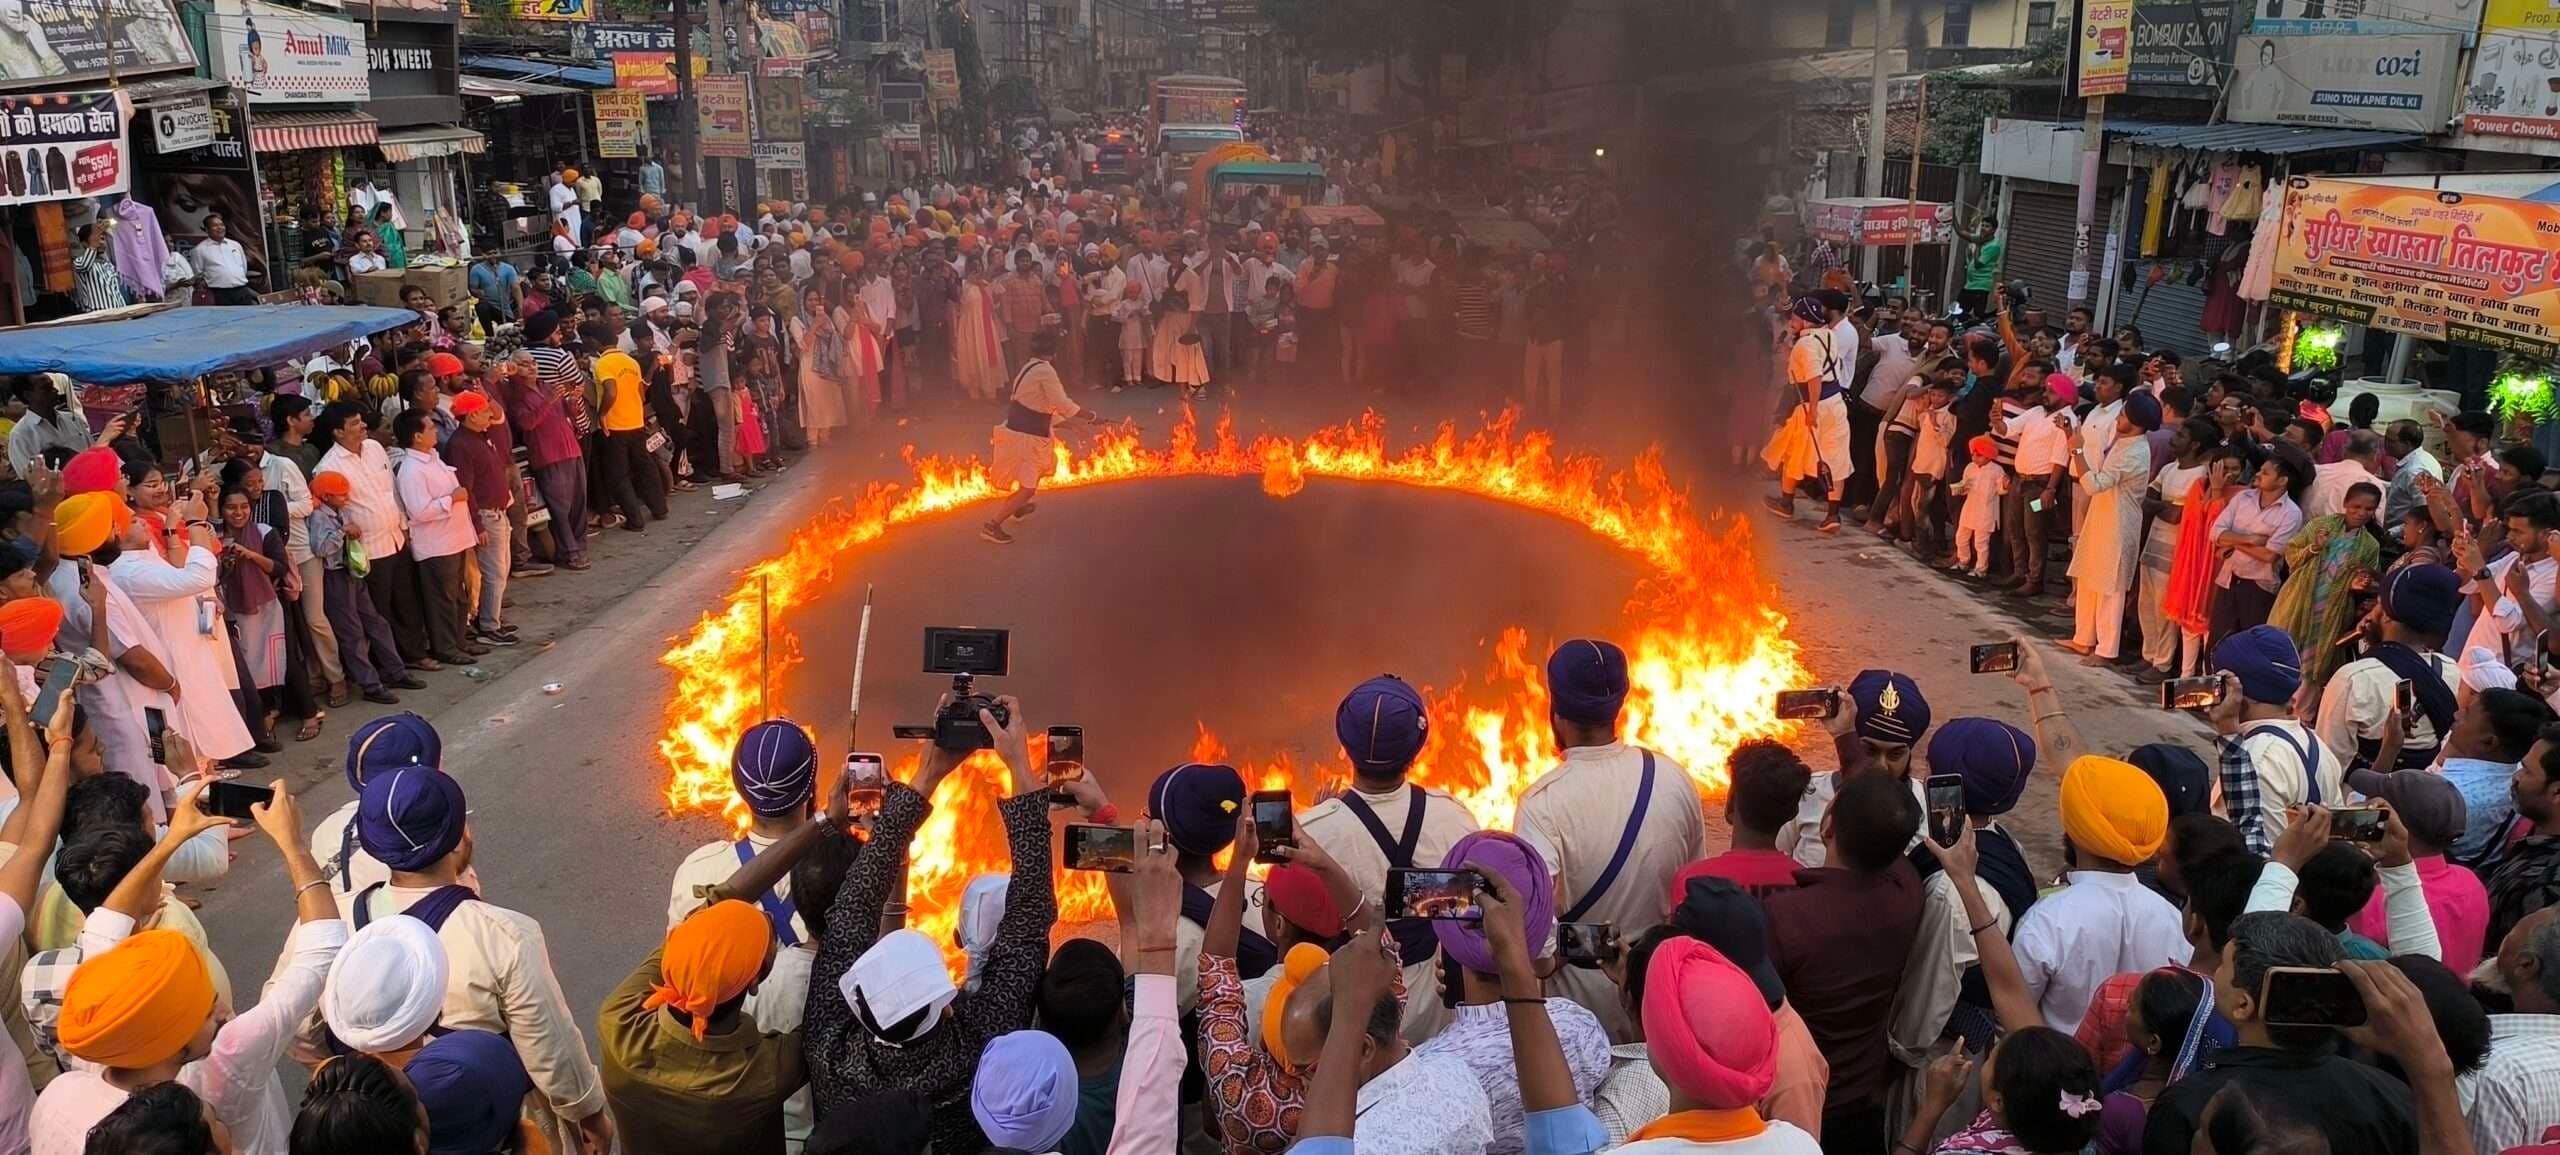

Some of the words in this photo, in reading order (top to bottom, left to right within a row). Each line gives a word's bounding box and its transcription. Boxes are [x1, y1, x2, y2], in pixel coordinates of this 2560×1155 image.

[2524, 11, 2553, 25] Prop.
[285, 29, 324, 56] Amul
[326, 35, 351, 56] Milk
[594, 29, 651, 48] अरुण
[2136, 23, 2182, 47] BOMBAY
[2184, 20, 2228, 46] SAON
[393, 48, 432, 70] SWEETS
[2375, 49, 2422, 77] cozi
[2316, 93, 2338, 103] SUNO
[2340, 94, 2361, 105] TOH
[2362, 95, 2388, 106] APNE
[2390, 97, 2408, 107] DIL
[2409, 98, 2419, 108] KI
[177, 113, 208, 126] ADVOCATE
[2472, 119, 2509, 132] Tower
[2511, 121, 2557, 138] Chowk,
[2448, 223, 2547, 293] तिलकुट
[2293, 265, 2310, 276] गया
[2313, 267, 2336, 281] जिला
[2503, 318, 2530, 334] जाता
